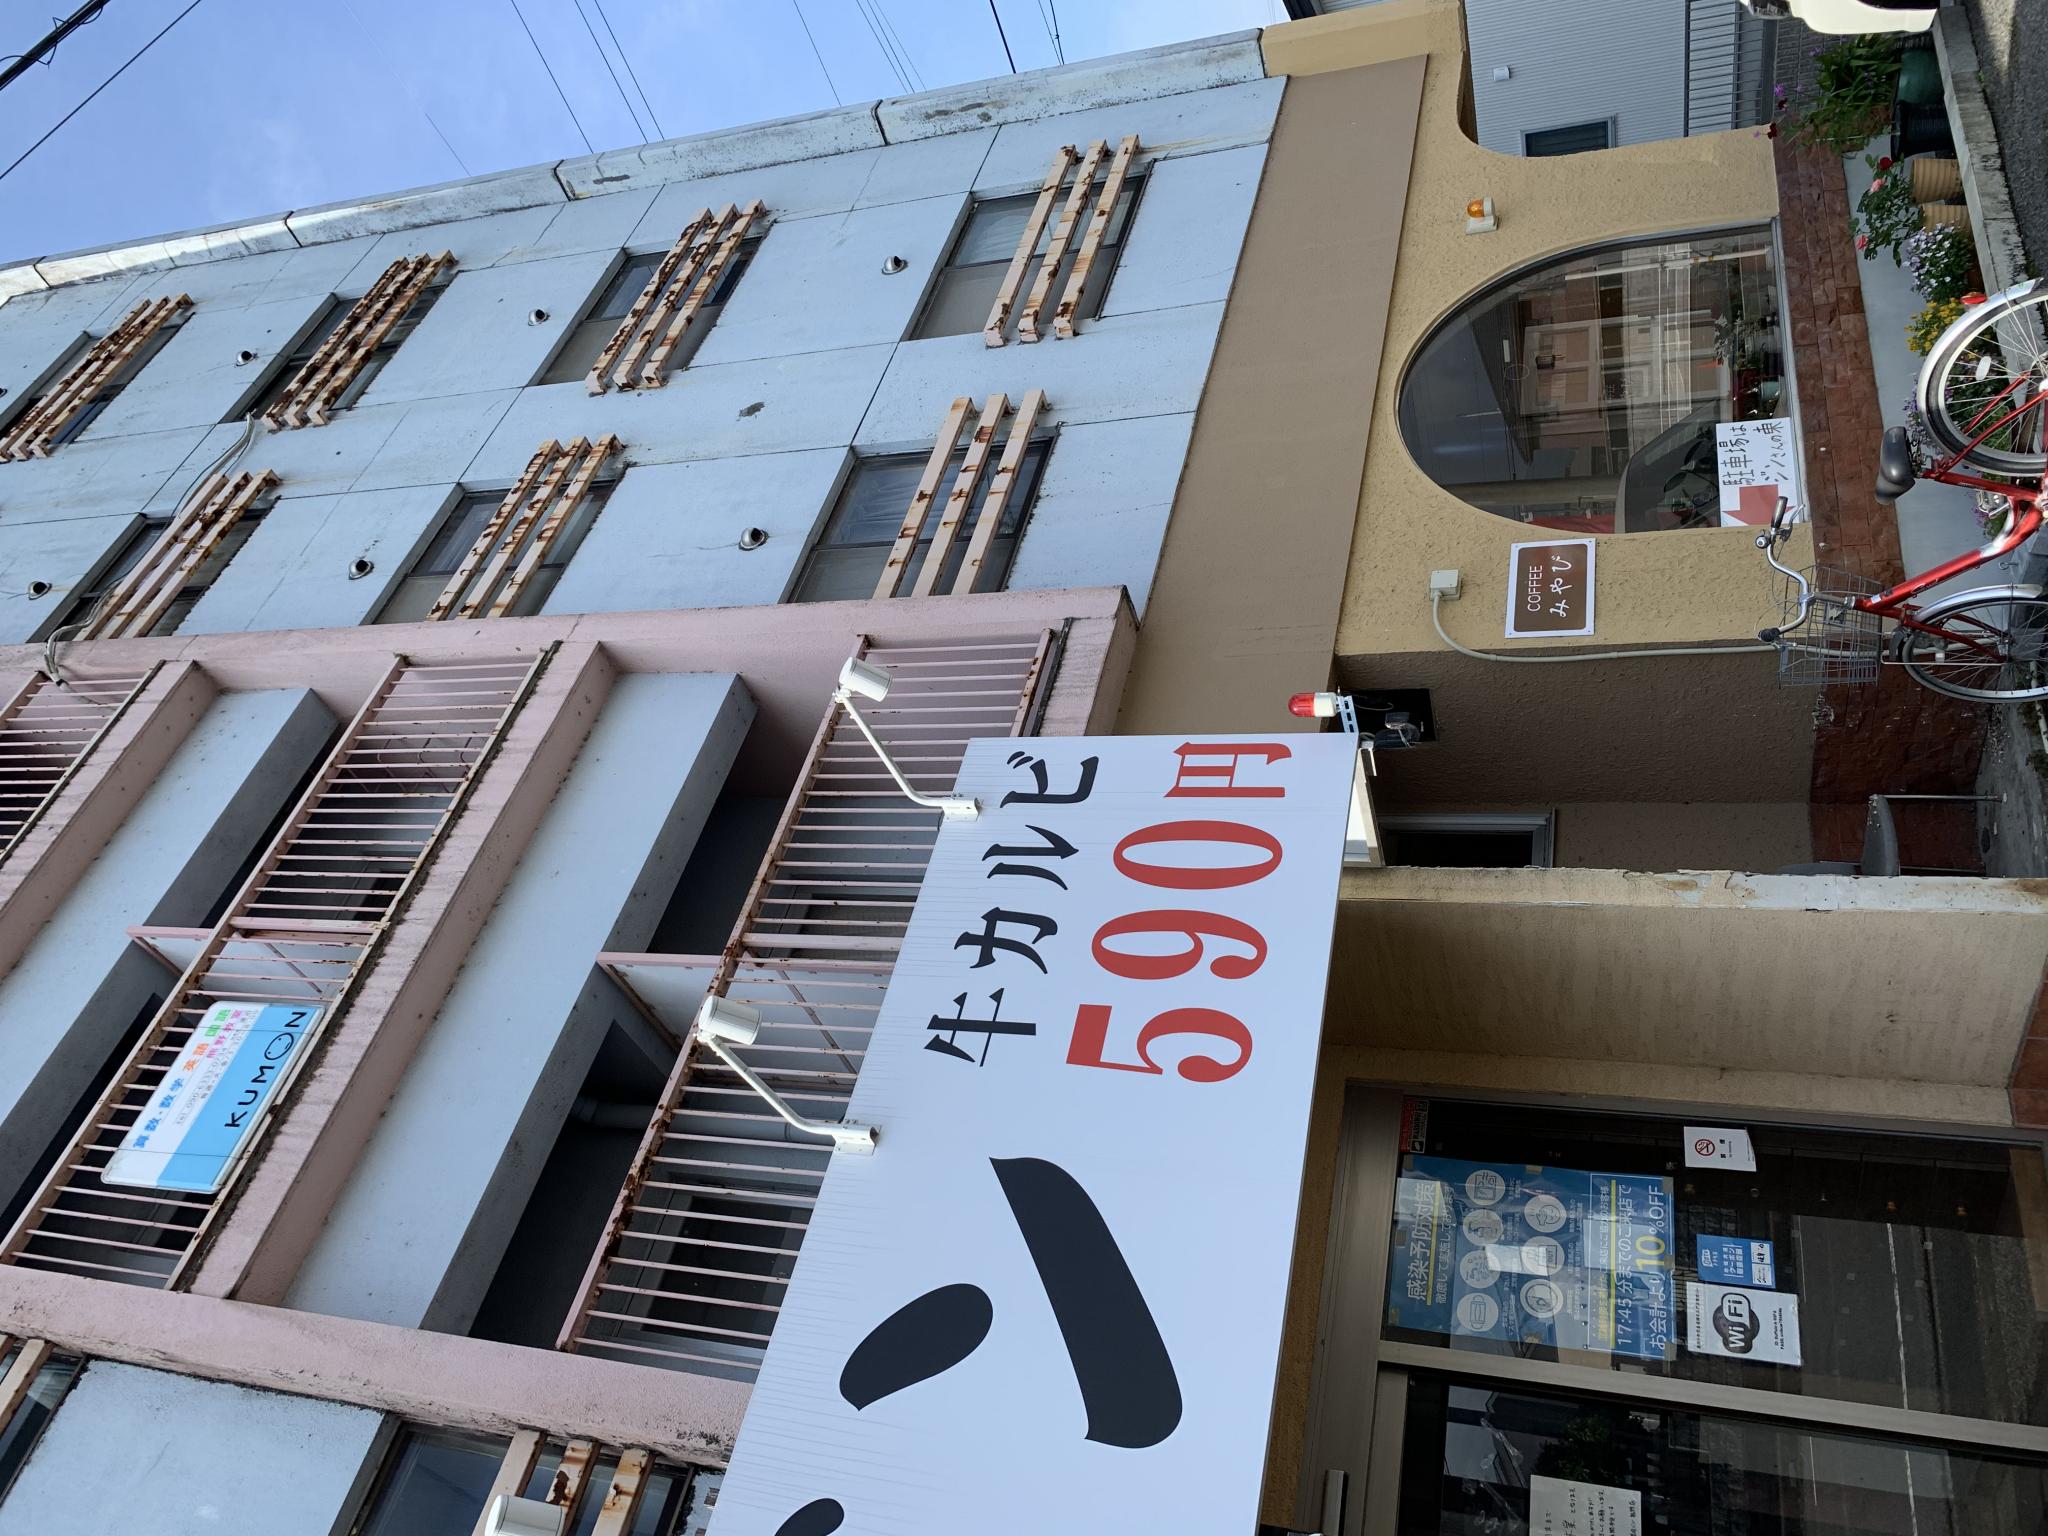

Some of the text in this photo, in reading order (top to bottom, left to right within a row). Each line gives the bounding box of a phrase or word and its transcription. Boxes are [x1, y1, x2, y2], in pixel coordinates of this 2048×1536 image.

[1718, 424, 1755, 486] 駐車場は
[1753, 420, 1788, 482] ジンさんの東
[1527, 564, 1543, 612] COFFEE
[1549, 553, 1573, 618] みやび
[920, 752, 1102, 1067] 牛カルビ
[1067, 740, 1294, 1083] 590円
[181, 1042, 210, 1072] 英語
[204, 1009, 231, 1038] 国語
[224, 1011, 307, 1128] KUMON
[1406, 1181, 1435, 1300] 感染予防対策
[776, 1157, 1184, 1536] ン
